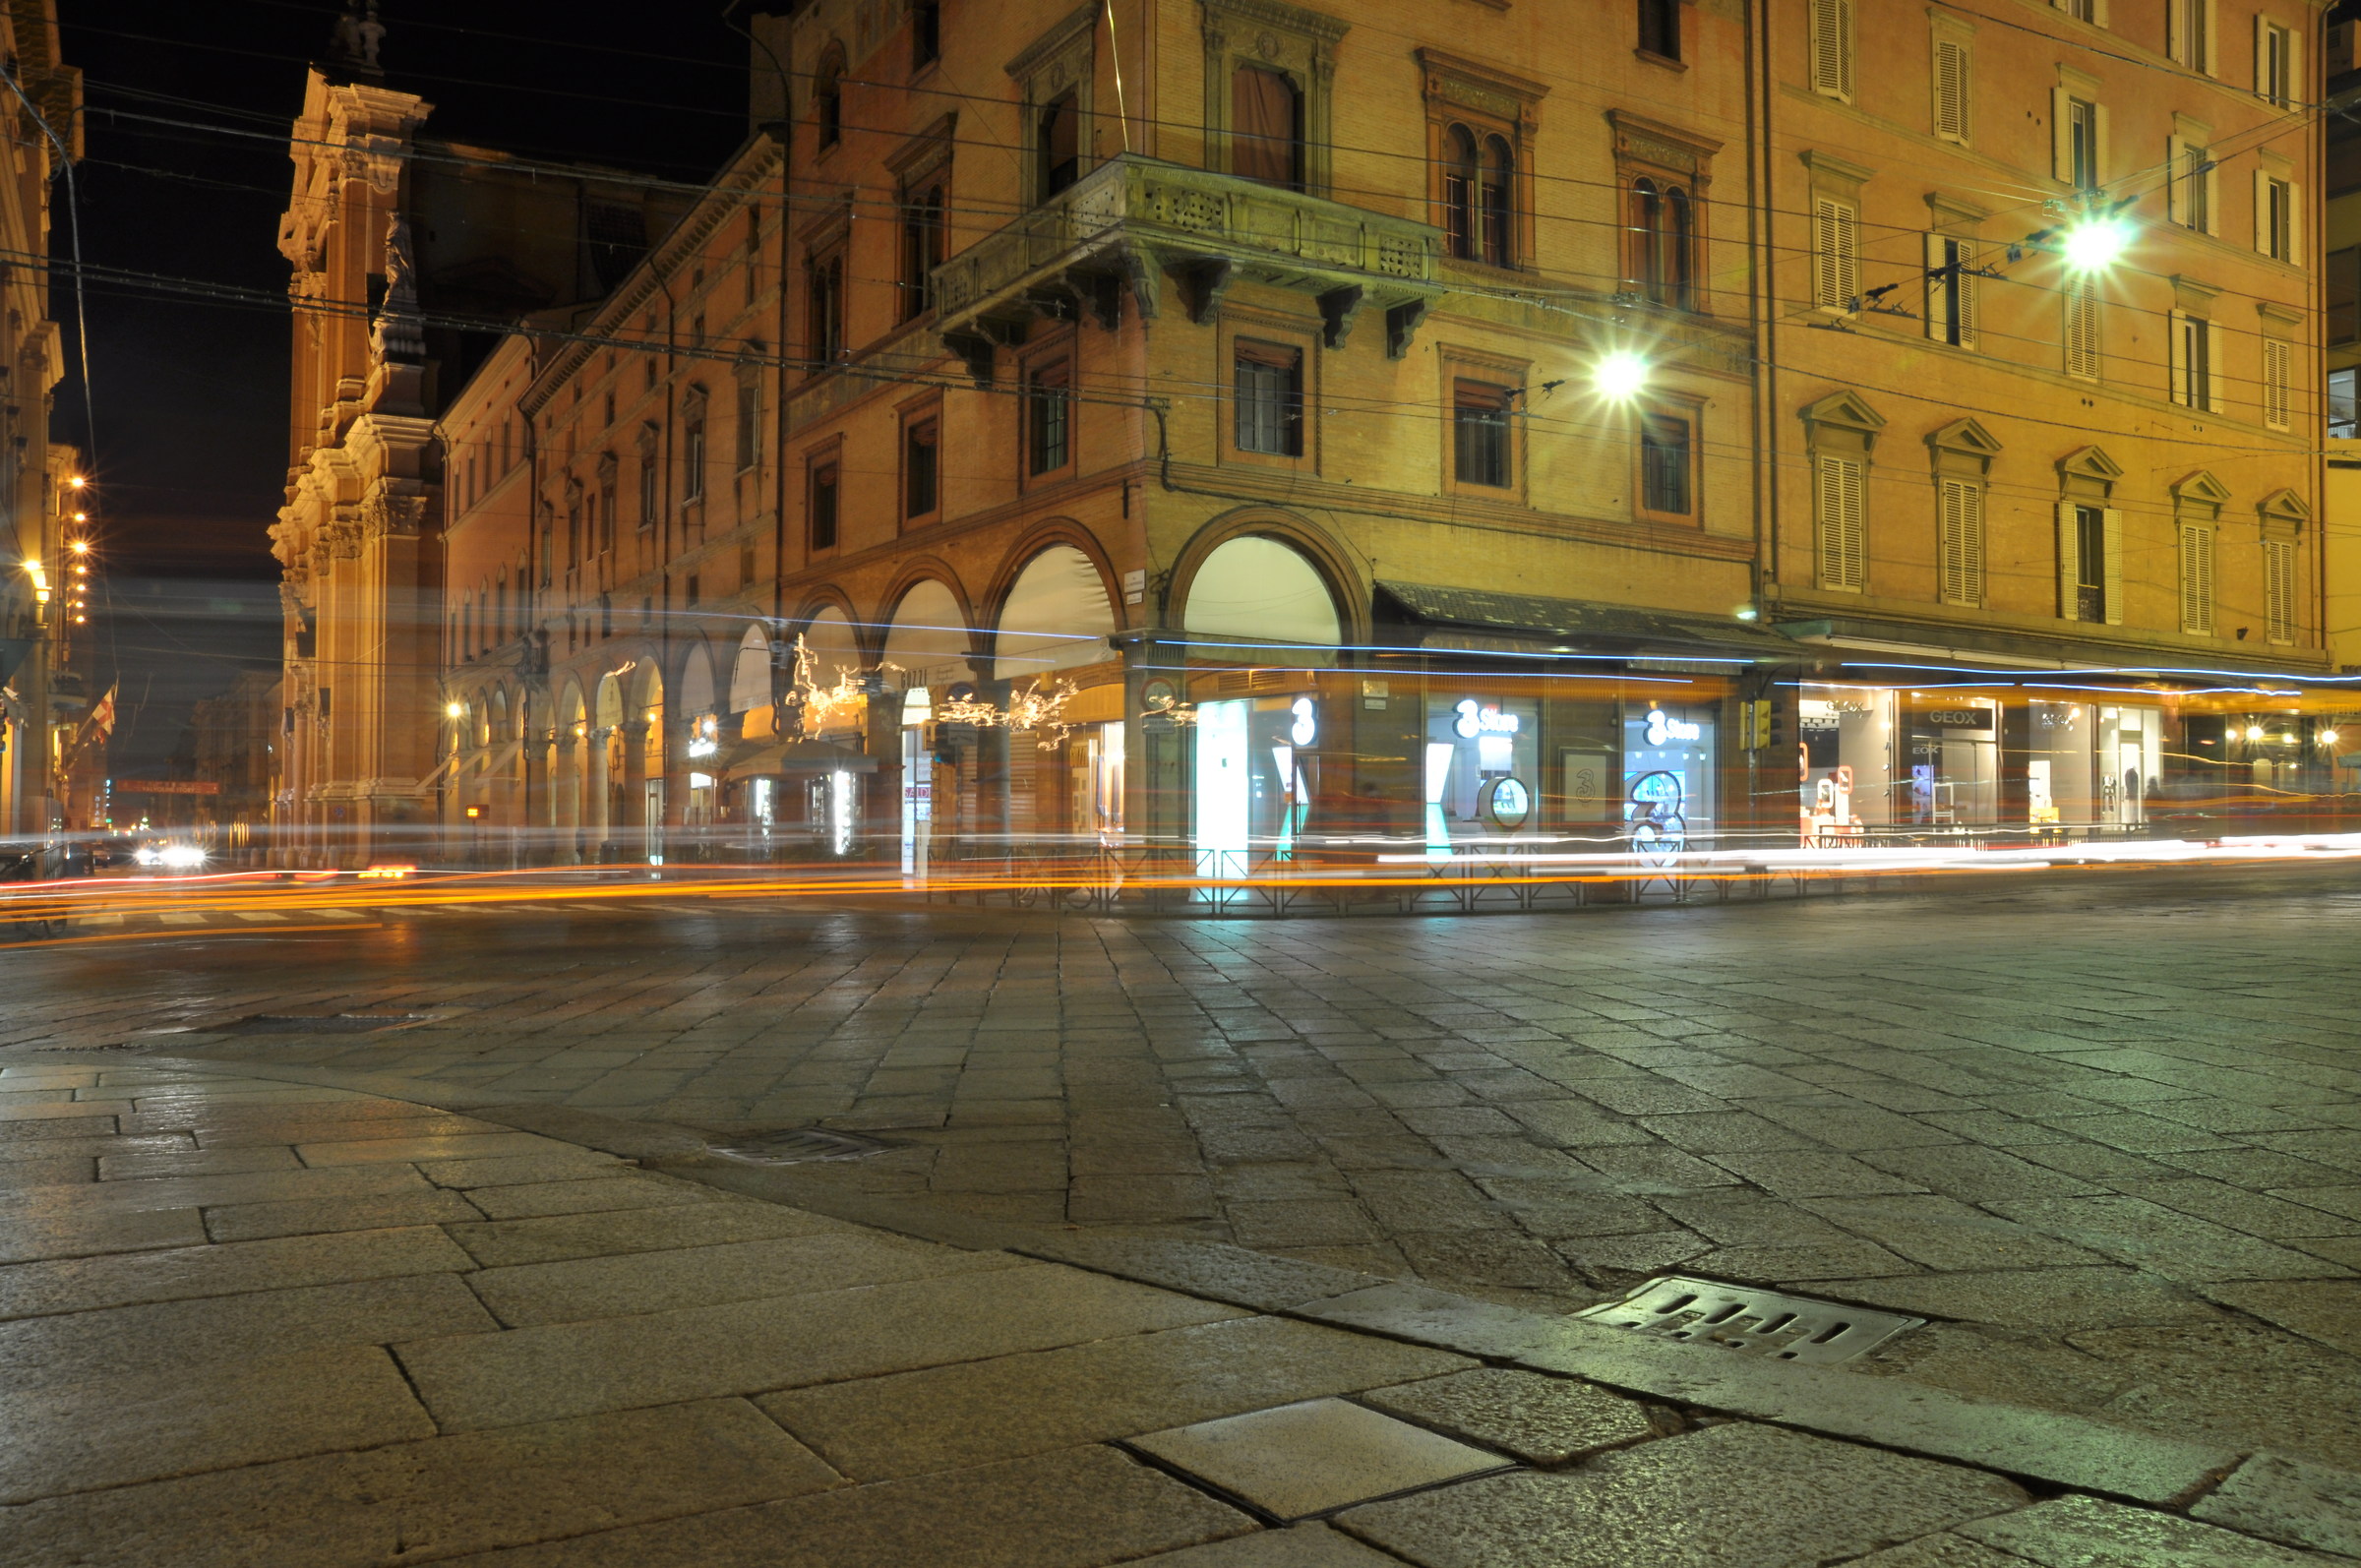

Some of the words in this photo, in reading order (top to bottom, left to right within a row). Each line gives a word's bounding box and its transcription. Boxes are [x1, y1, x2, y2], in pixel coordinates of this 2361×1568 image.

[1292, 697, 1315, 746] 3
[1457, 699, 1480, 738] 3
[1480, 708, 1519, 732] Store
[1647, 710, 1666, 746] 3
[1666, 718, 1700, 740] Store
[1929, 710, 1977, 725] GEOX
[905, 787, 931, 798] SALDI
[1576, 768, 1596, 803] 3
